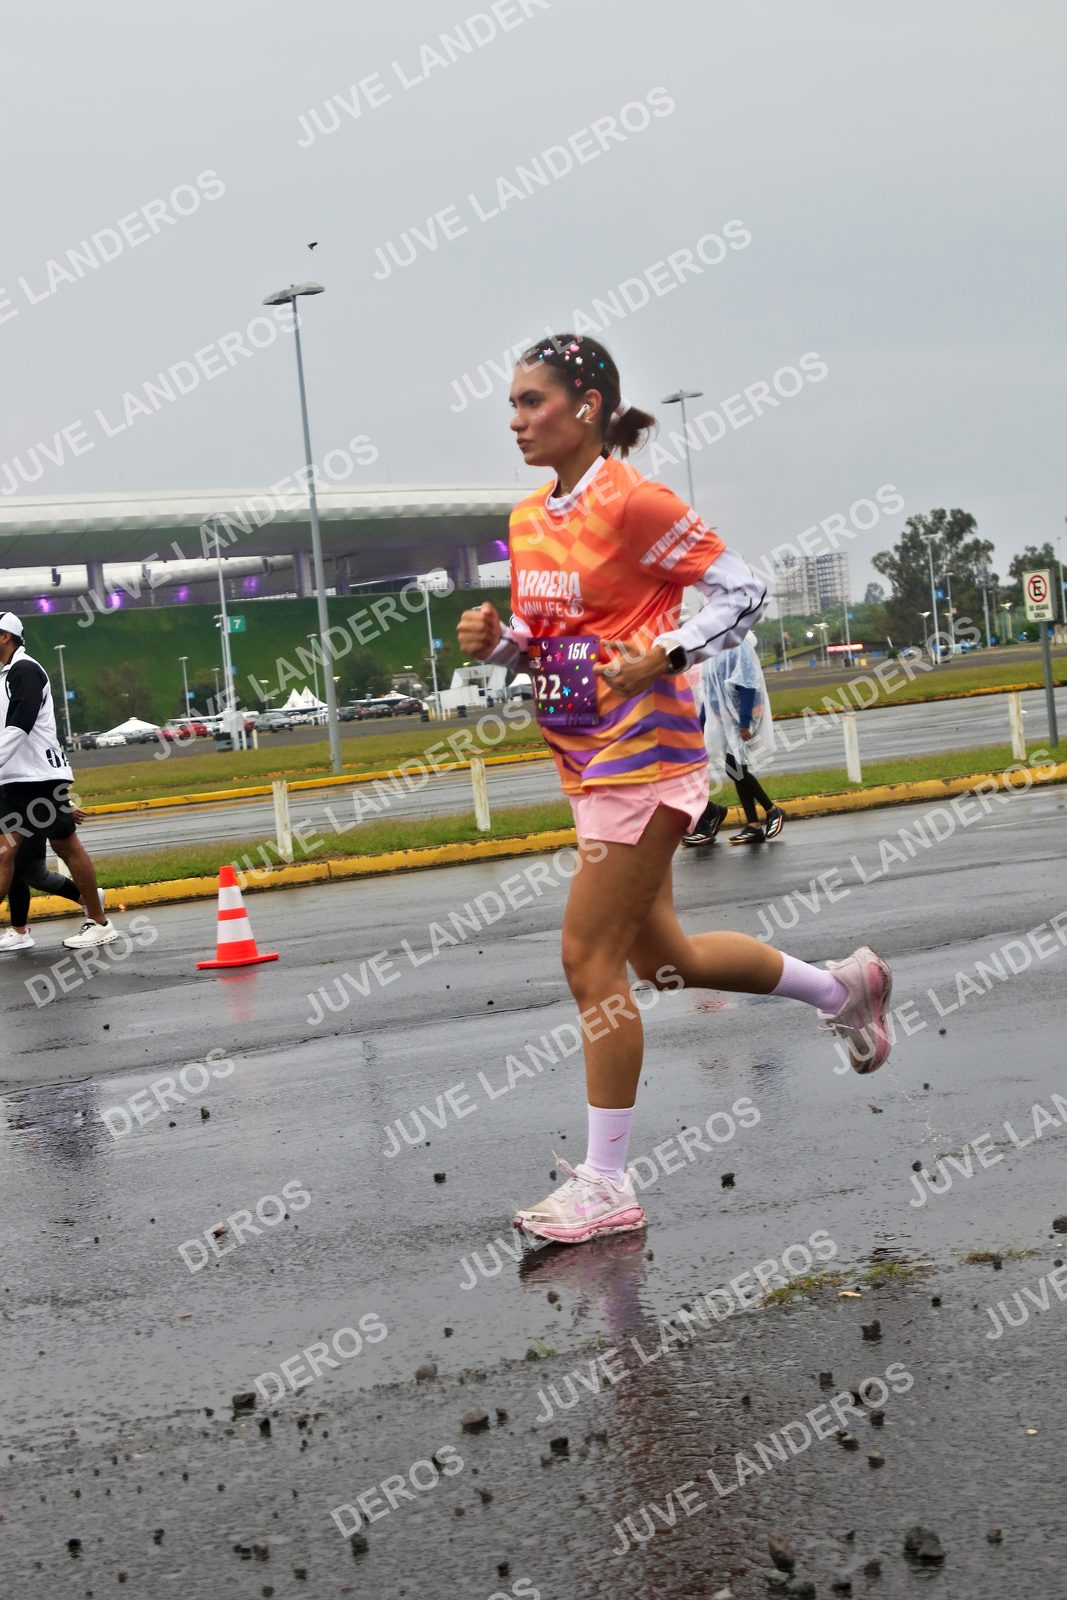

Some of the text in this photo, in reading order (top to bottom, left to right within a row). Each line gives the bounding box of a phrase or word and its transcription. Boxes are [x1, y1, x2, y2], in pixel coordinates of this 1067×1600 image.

[234, 619, 241, 629] 7
[567, 643, 590, 660] 15K
[532, 673, 561, 700] 22
